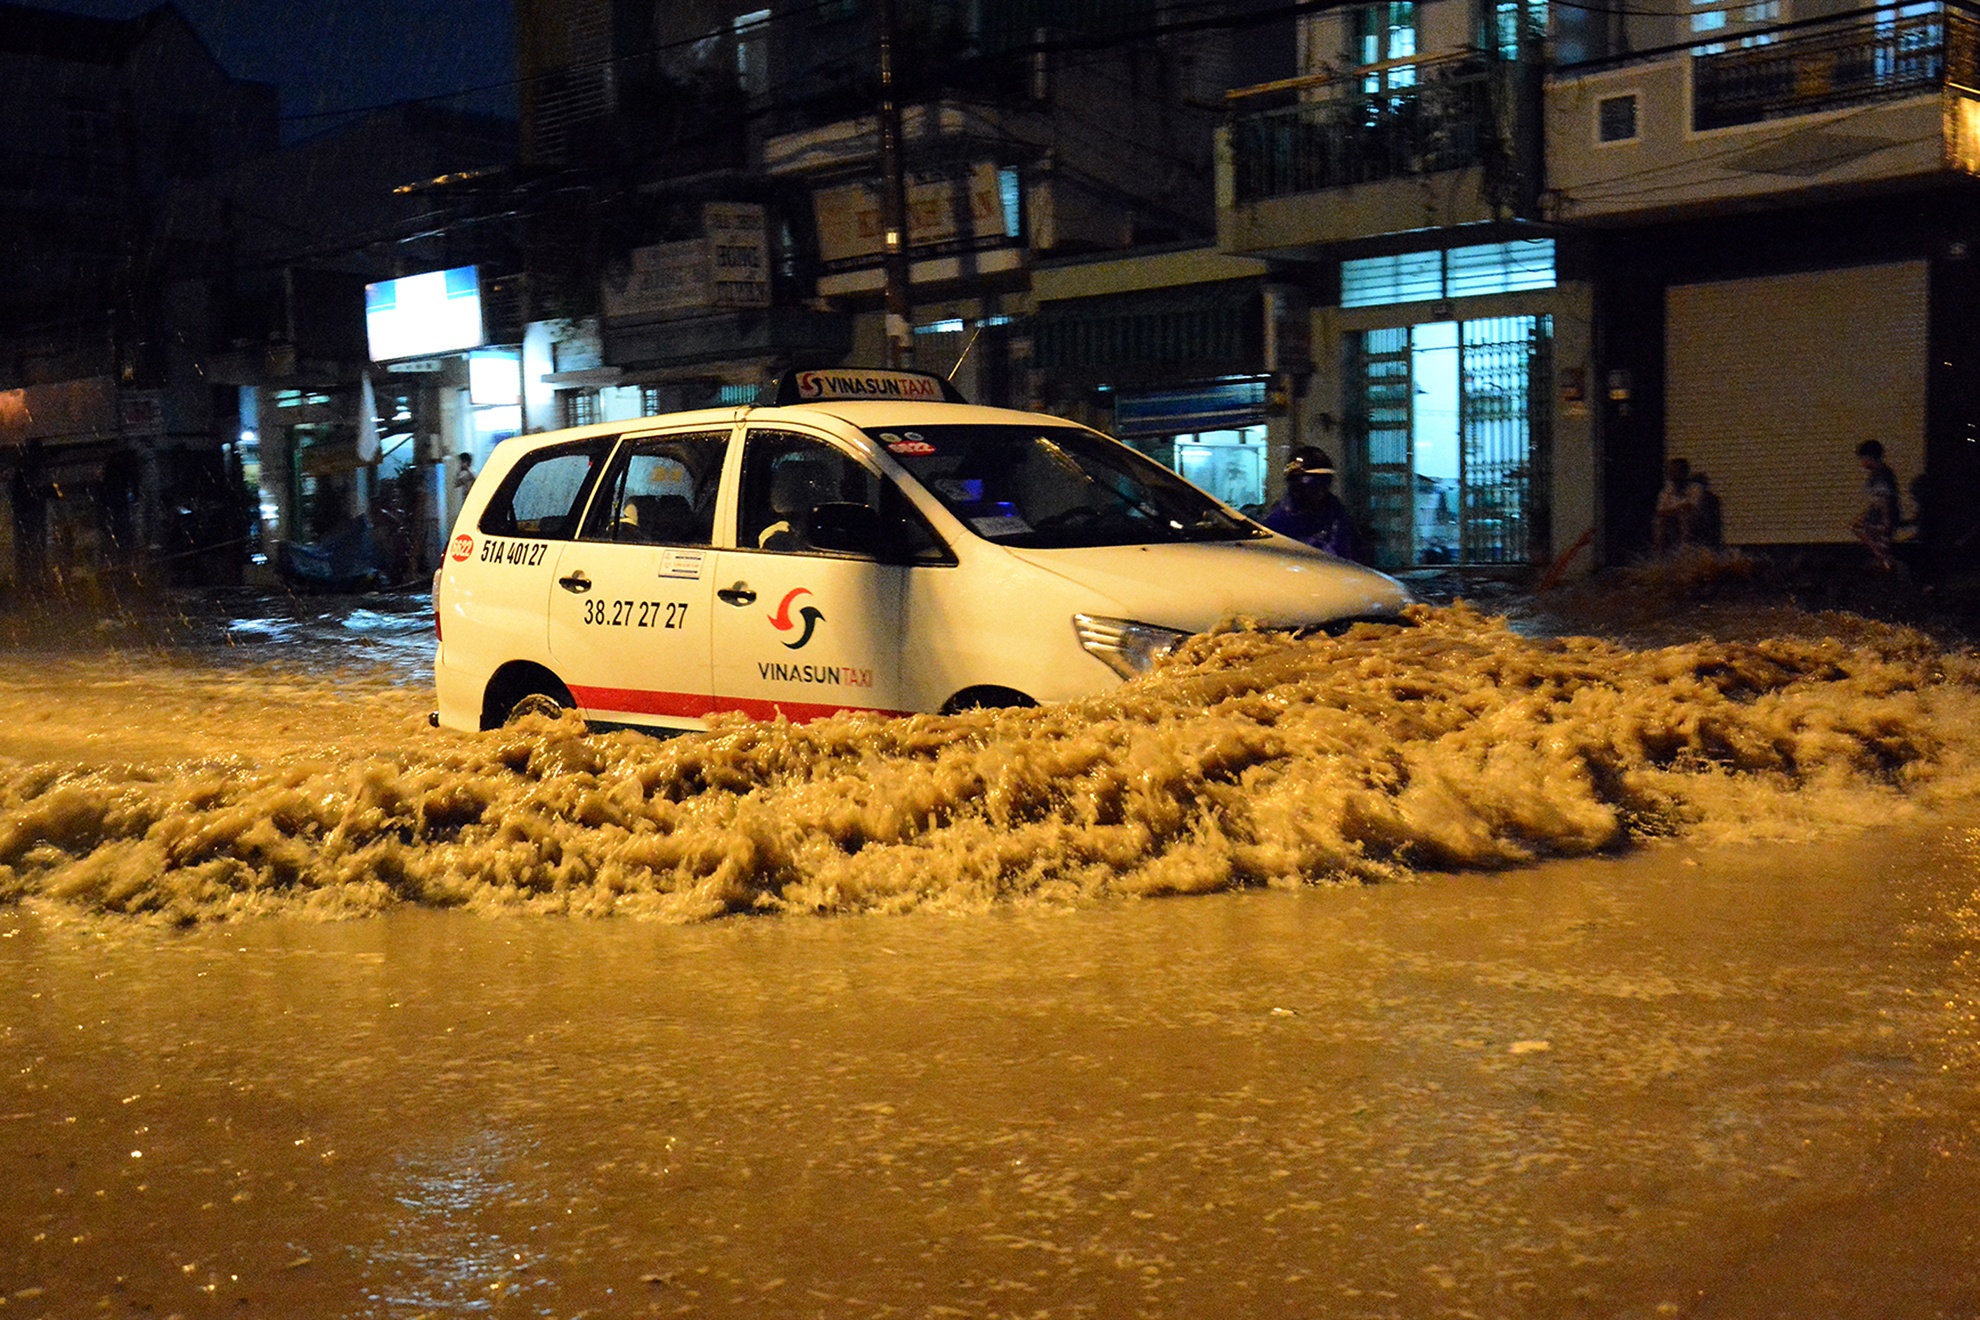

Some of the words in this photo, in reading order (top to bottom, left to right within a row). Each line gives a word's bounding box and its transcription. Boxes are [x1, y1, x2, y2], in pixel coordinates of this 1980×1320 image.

[481, 540, 505, 564] 51A
[584, 599, 634, 626] 38.27
[638, 601, 661, 628] 27
[665, 602, 688, 629] 27
